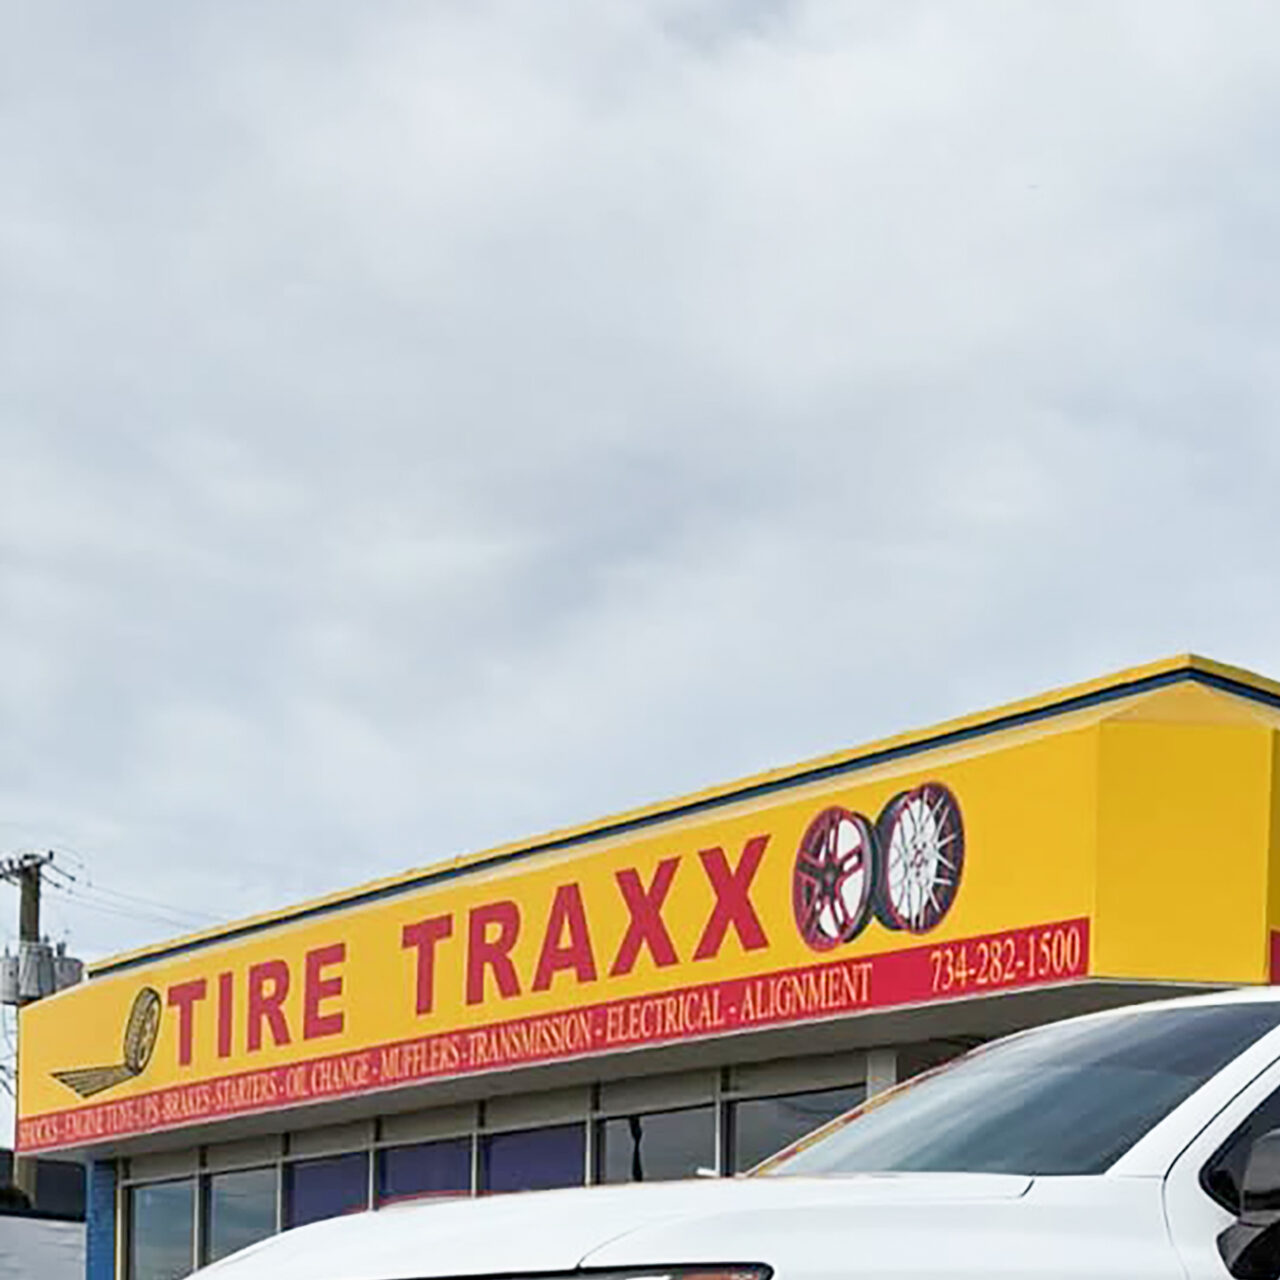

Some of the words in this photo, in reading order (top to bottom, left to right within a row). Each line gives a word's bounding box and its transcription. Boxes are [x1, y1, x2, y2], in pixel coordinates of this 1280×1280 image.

[167, 942, 346, 1067] TIRE
[401, 833, 771, 1017] TRAXX
[930, 926, 1081, 993] 734-282-1500
[286, 1064, 309, 1098] OIL
[606, 989, 725, 1042] ELECTRICAL
[740, 963, 873, 1021] ALIGNMENT
